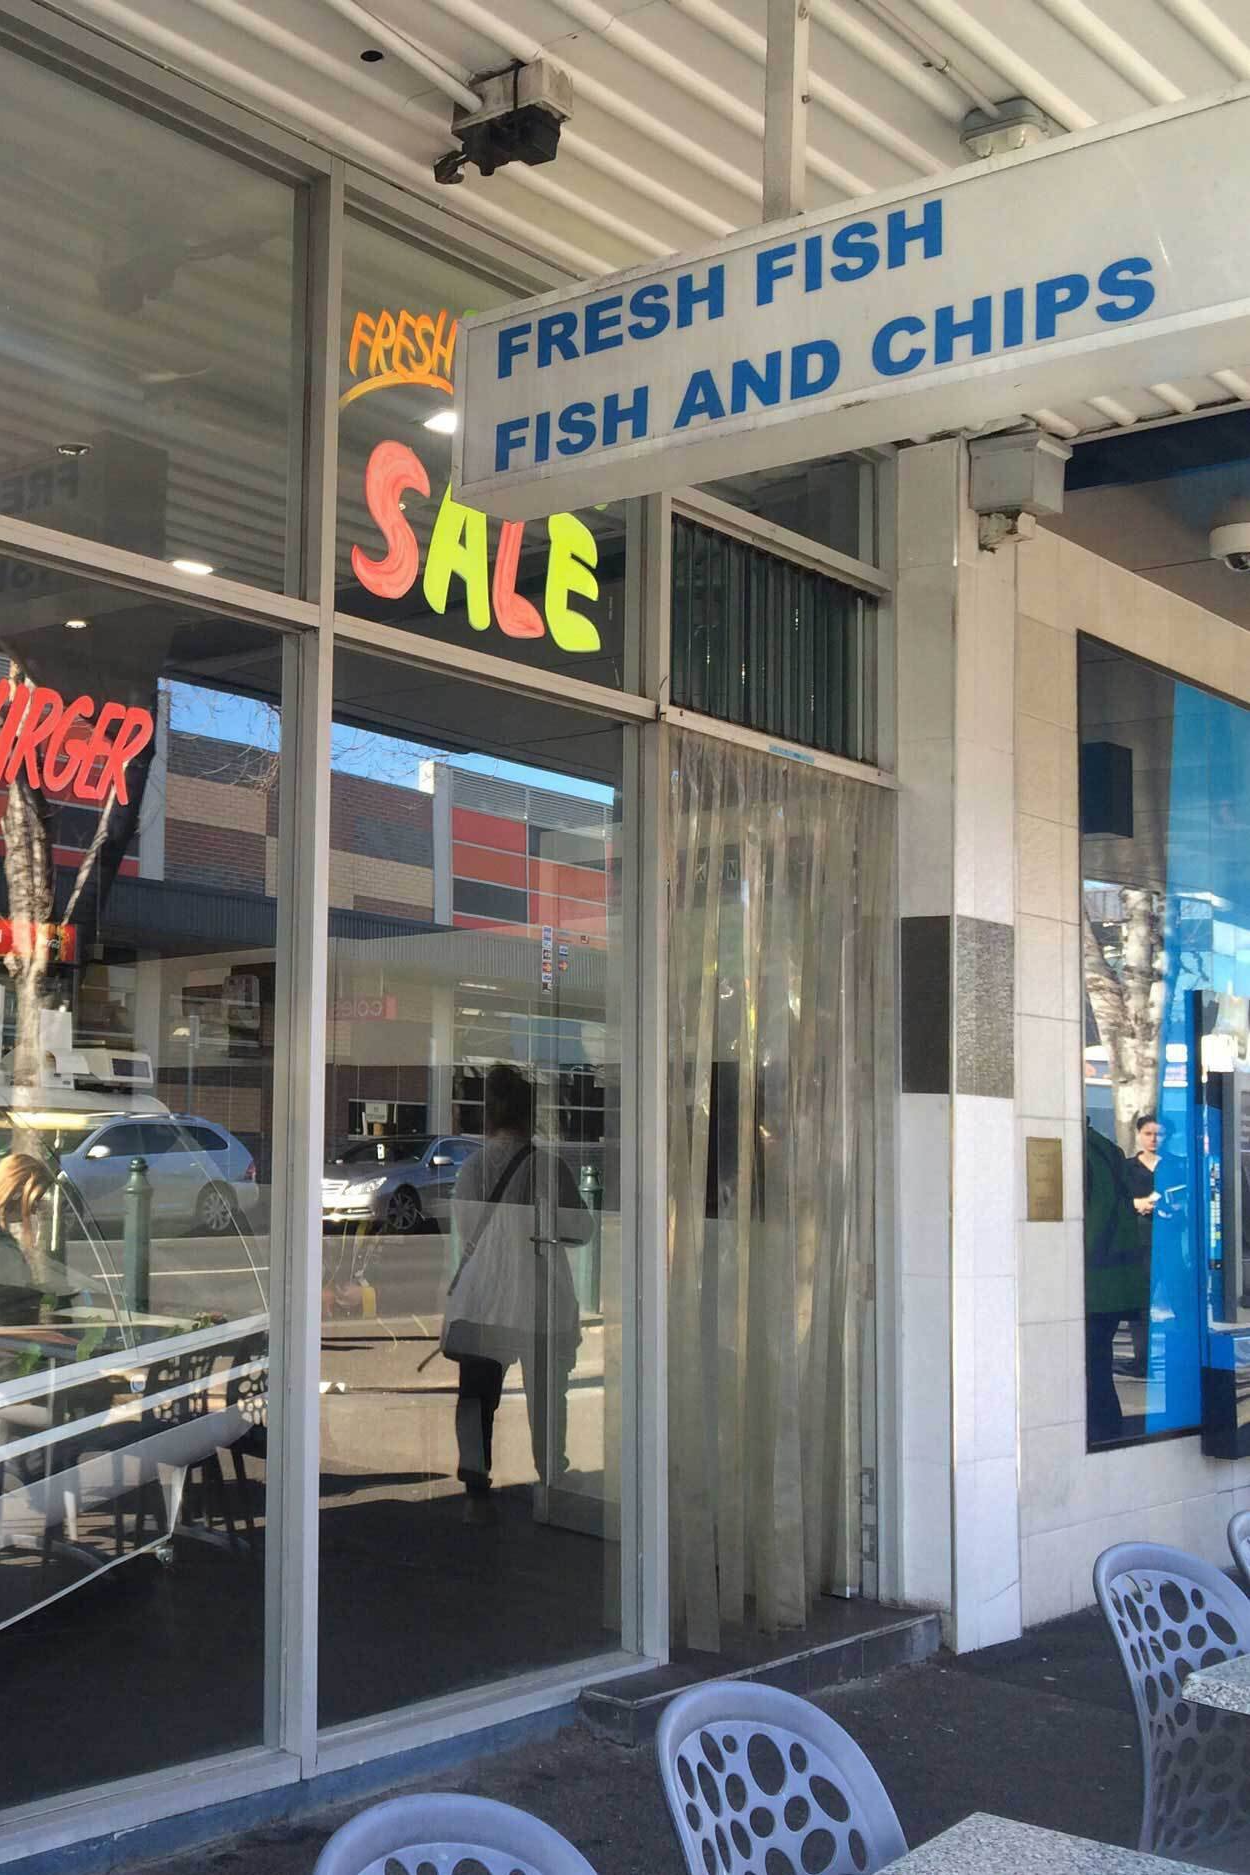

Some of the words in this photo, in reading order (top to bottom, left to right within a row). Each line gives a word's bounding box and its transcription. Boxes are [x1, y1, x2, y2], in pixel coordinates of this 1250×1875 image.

[348, 309, 457, 378] FRESH
[494, 385, 649, 472] FISH
[674, 339, 840, 429] AND
[871, 256, 1156, 376] CHIPS
[497, 264, 725, 379] FRESH
[756, 199, 942, 307] FISH
[351, 439, 601, 653] SALE
